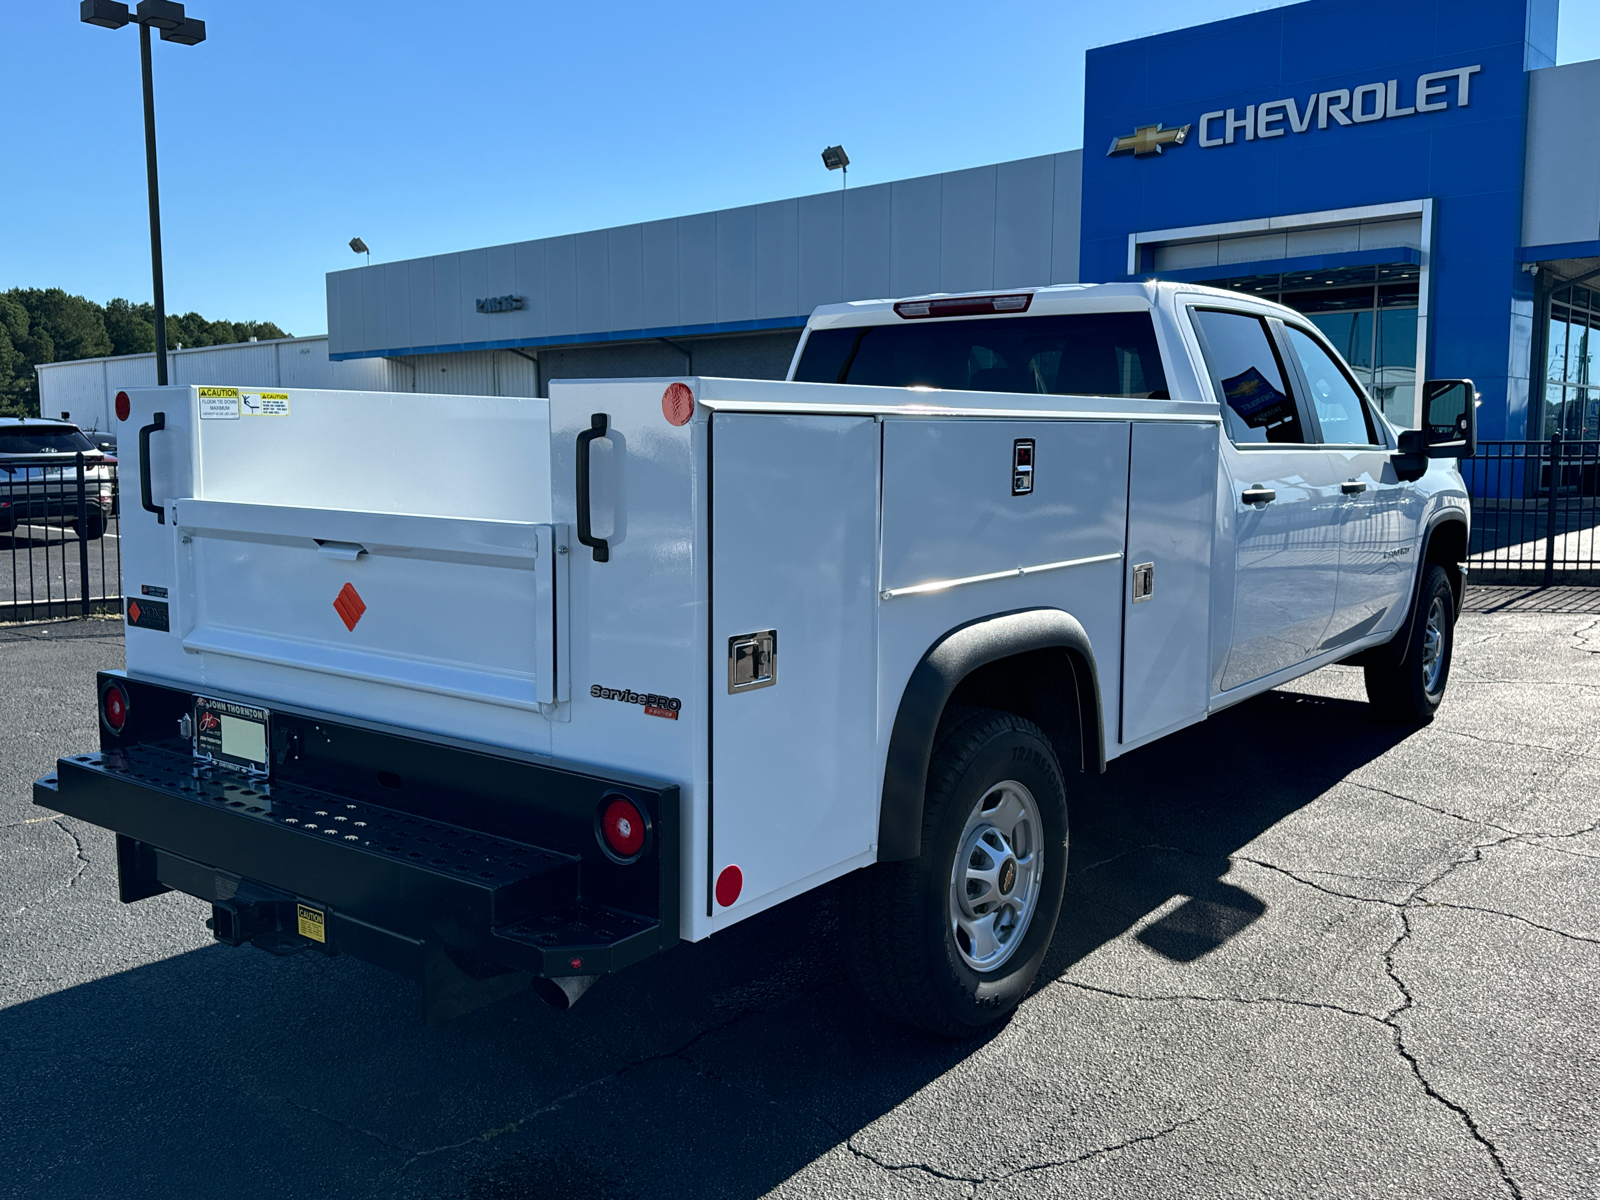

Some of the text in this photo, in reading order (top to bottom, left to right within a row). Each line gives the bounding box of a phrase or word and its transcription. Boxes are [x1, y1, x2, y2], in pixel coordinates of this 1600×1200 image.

[1199, 64, 1481, 148] CHEVROLET
[476, 295, 517, 313] PARTS
[206, 389, 238, 397] CAUTION
[590, 684, 682, 712] ServicePRO
[209, 700, 226, 712] JOHN
[227, 704, 263, 719] THORNTON
[300, 909, 323, 923] CAUTION
